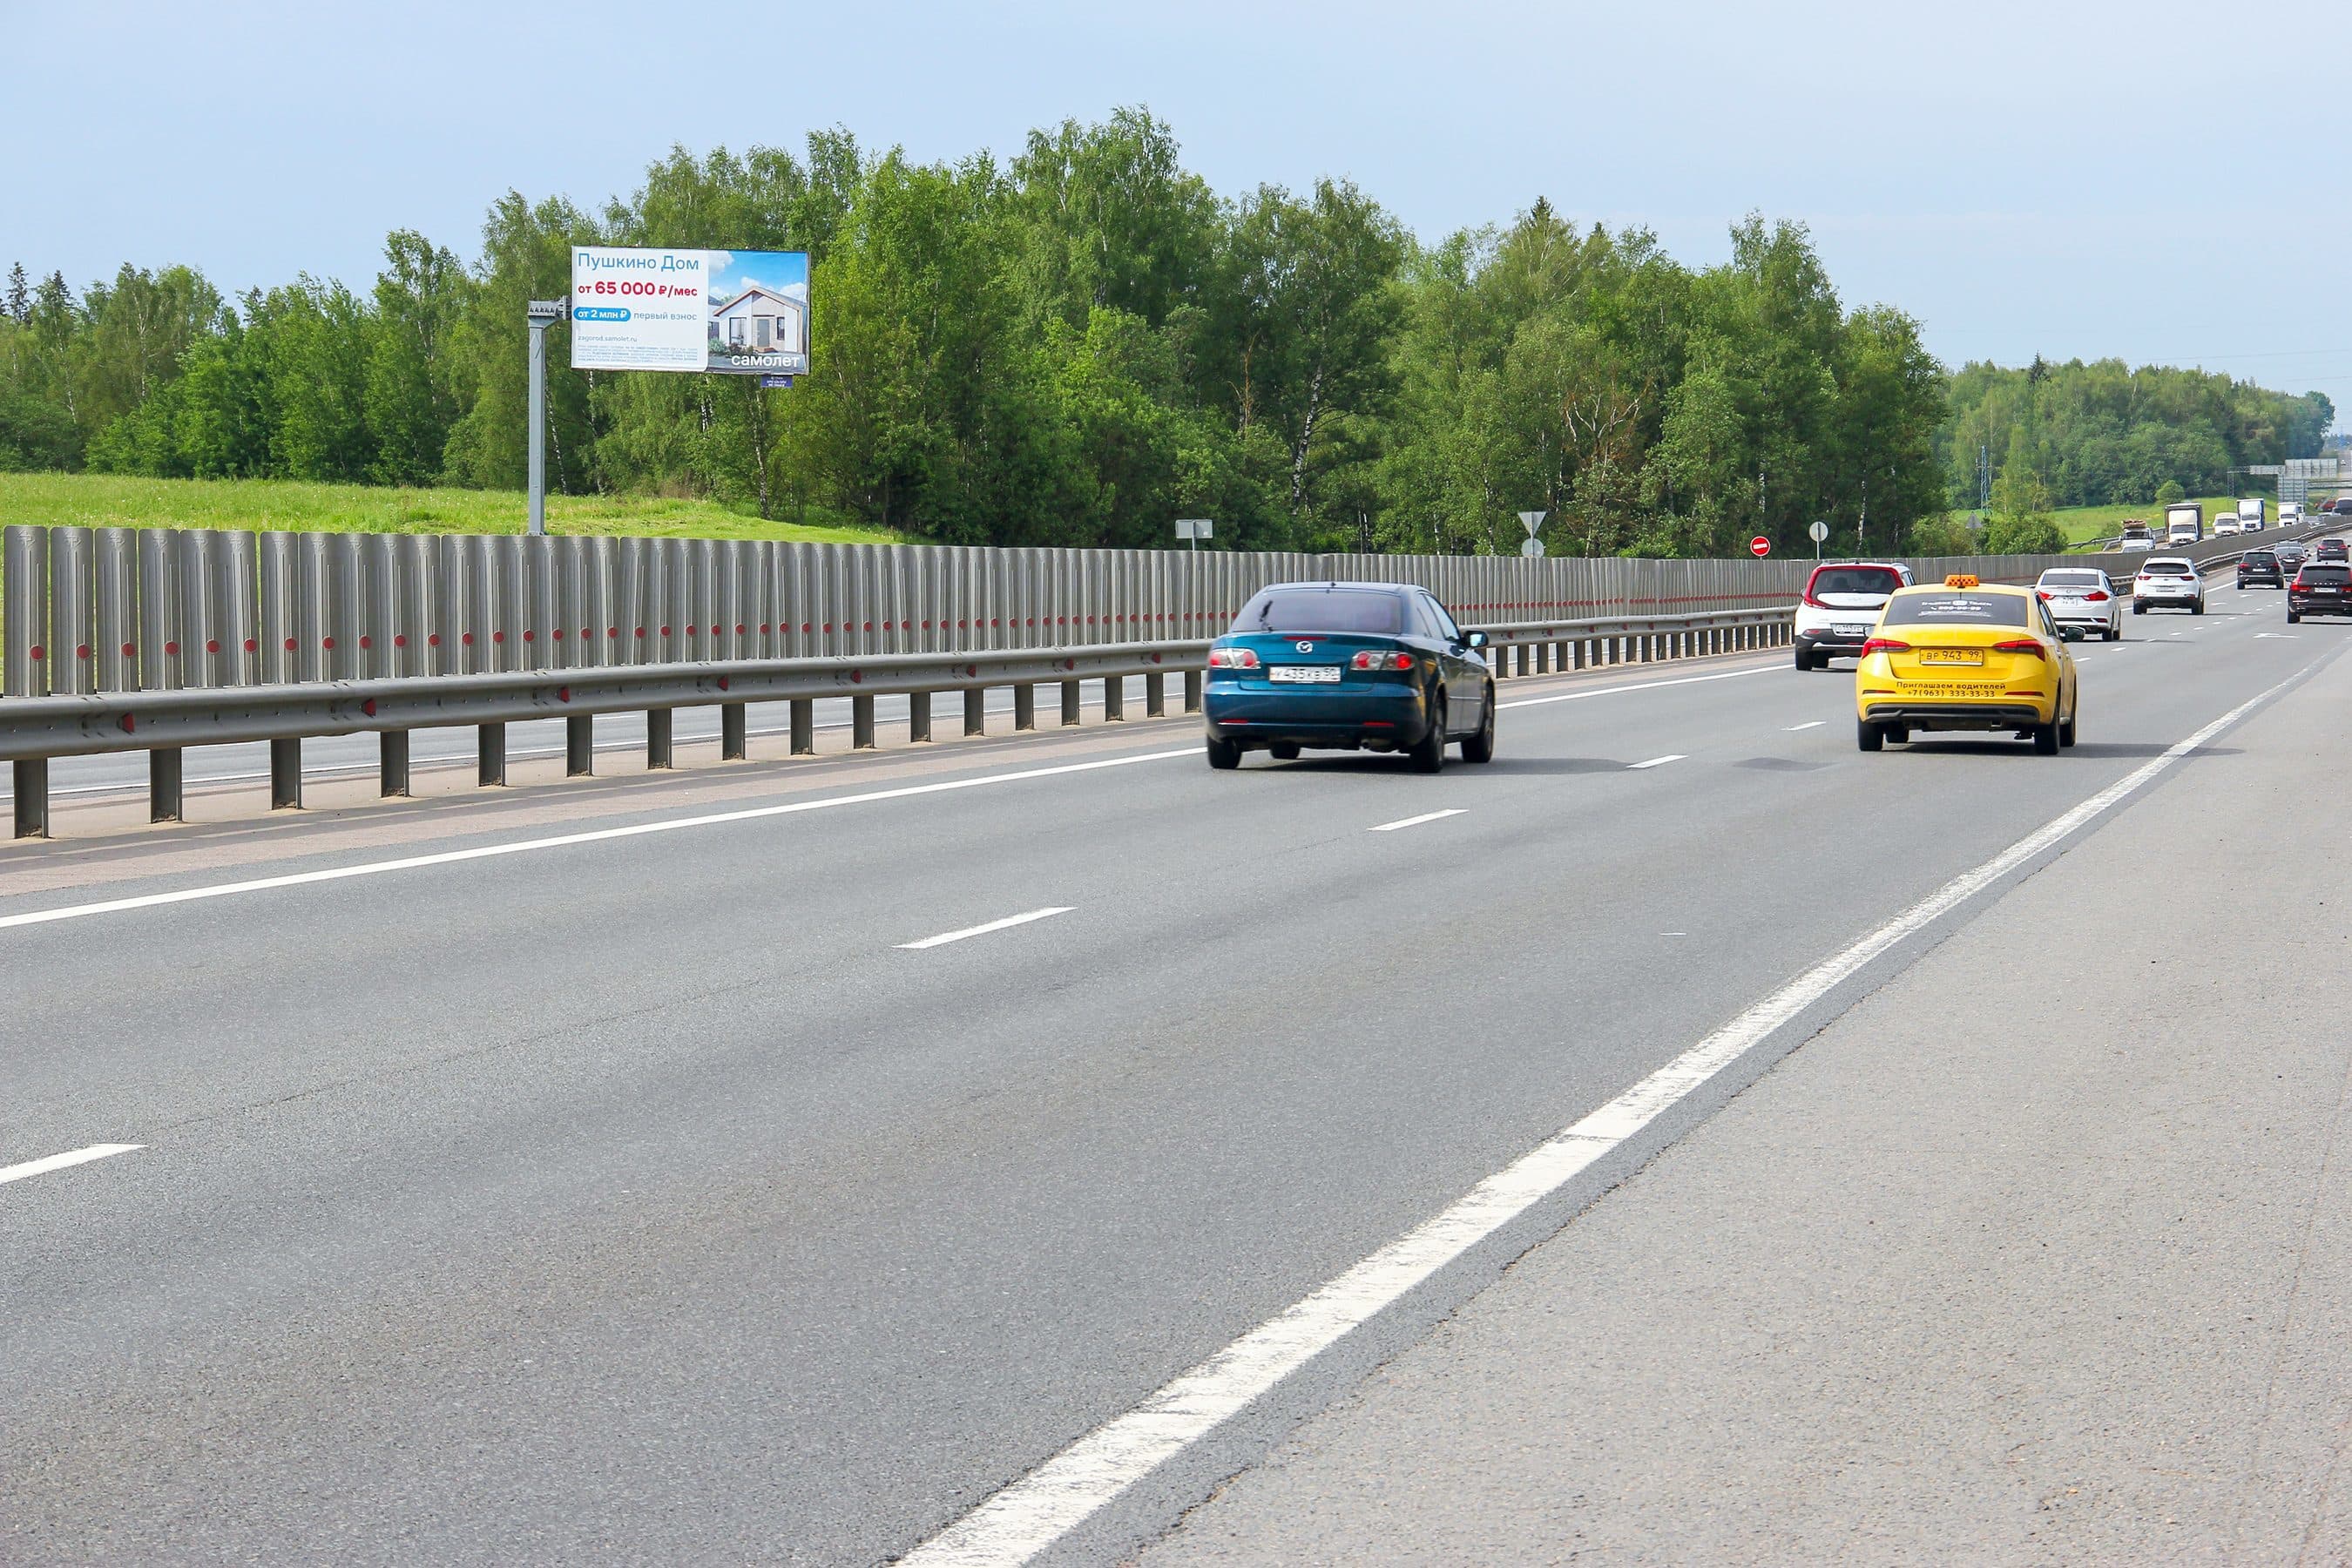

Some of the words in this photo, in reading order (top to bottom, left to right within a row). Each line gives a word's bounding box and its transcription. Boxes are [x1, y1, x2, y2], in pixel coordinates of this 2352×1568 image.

[578, 253, 656, 270] Пушкино
[661, 255, 699, 272] Дом
[595, 280, 617, 294] 65
[621, 281, 655, 295] 000
[591, 309, 598, 318] 2
[633, 311, 668, 321] первый
[671, 312, 697, 321] взнос
[732, 355, 800, 368] самолет
[1942, 651, 1962, 660] 943
